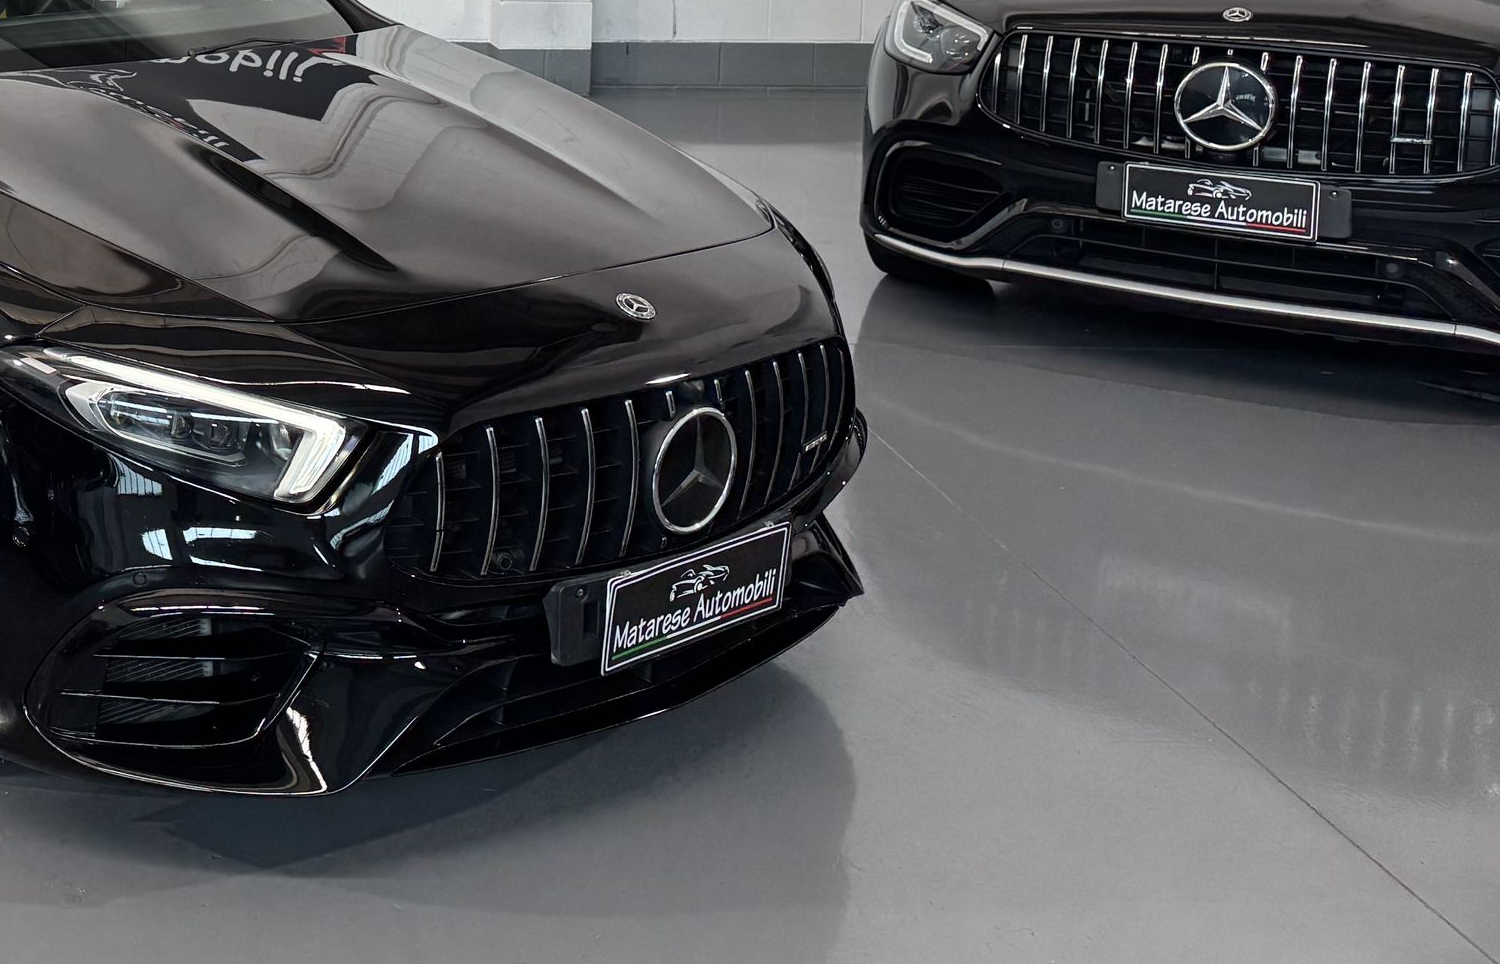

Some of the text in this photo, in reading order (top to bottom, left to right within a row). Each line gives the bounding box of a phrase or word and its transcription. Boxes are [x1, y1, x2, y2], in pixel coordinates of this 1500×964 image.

[1131, 190, 1308, 228] Matarese Automobili
[613, 568, 777, 653] Matarese Automobili
